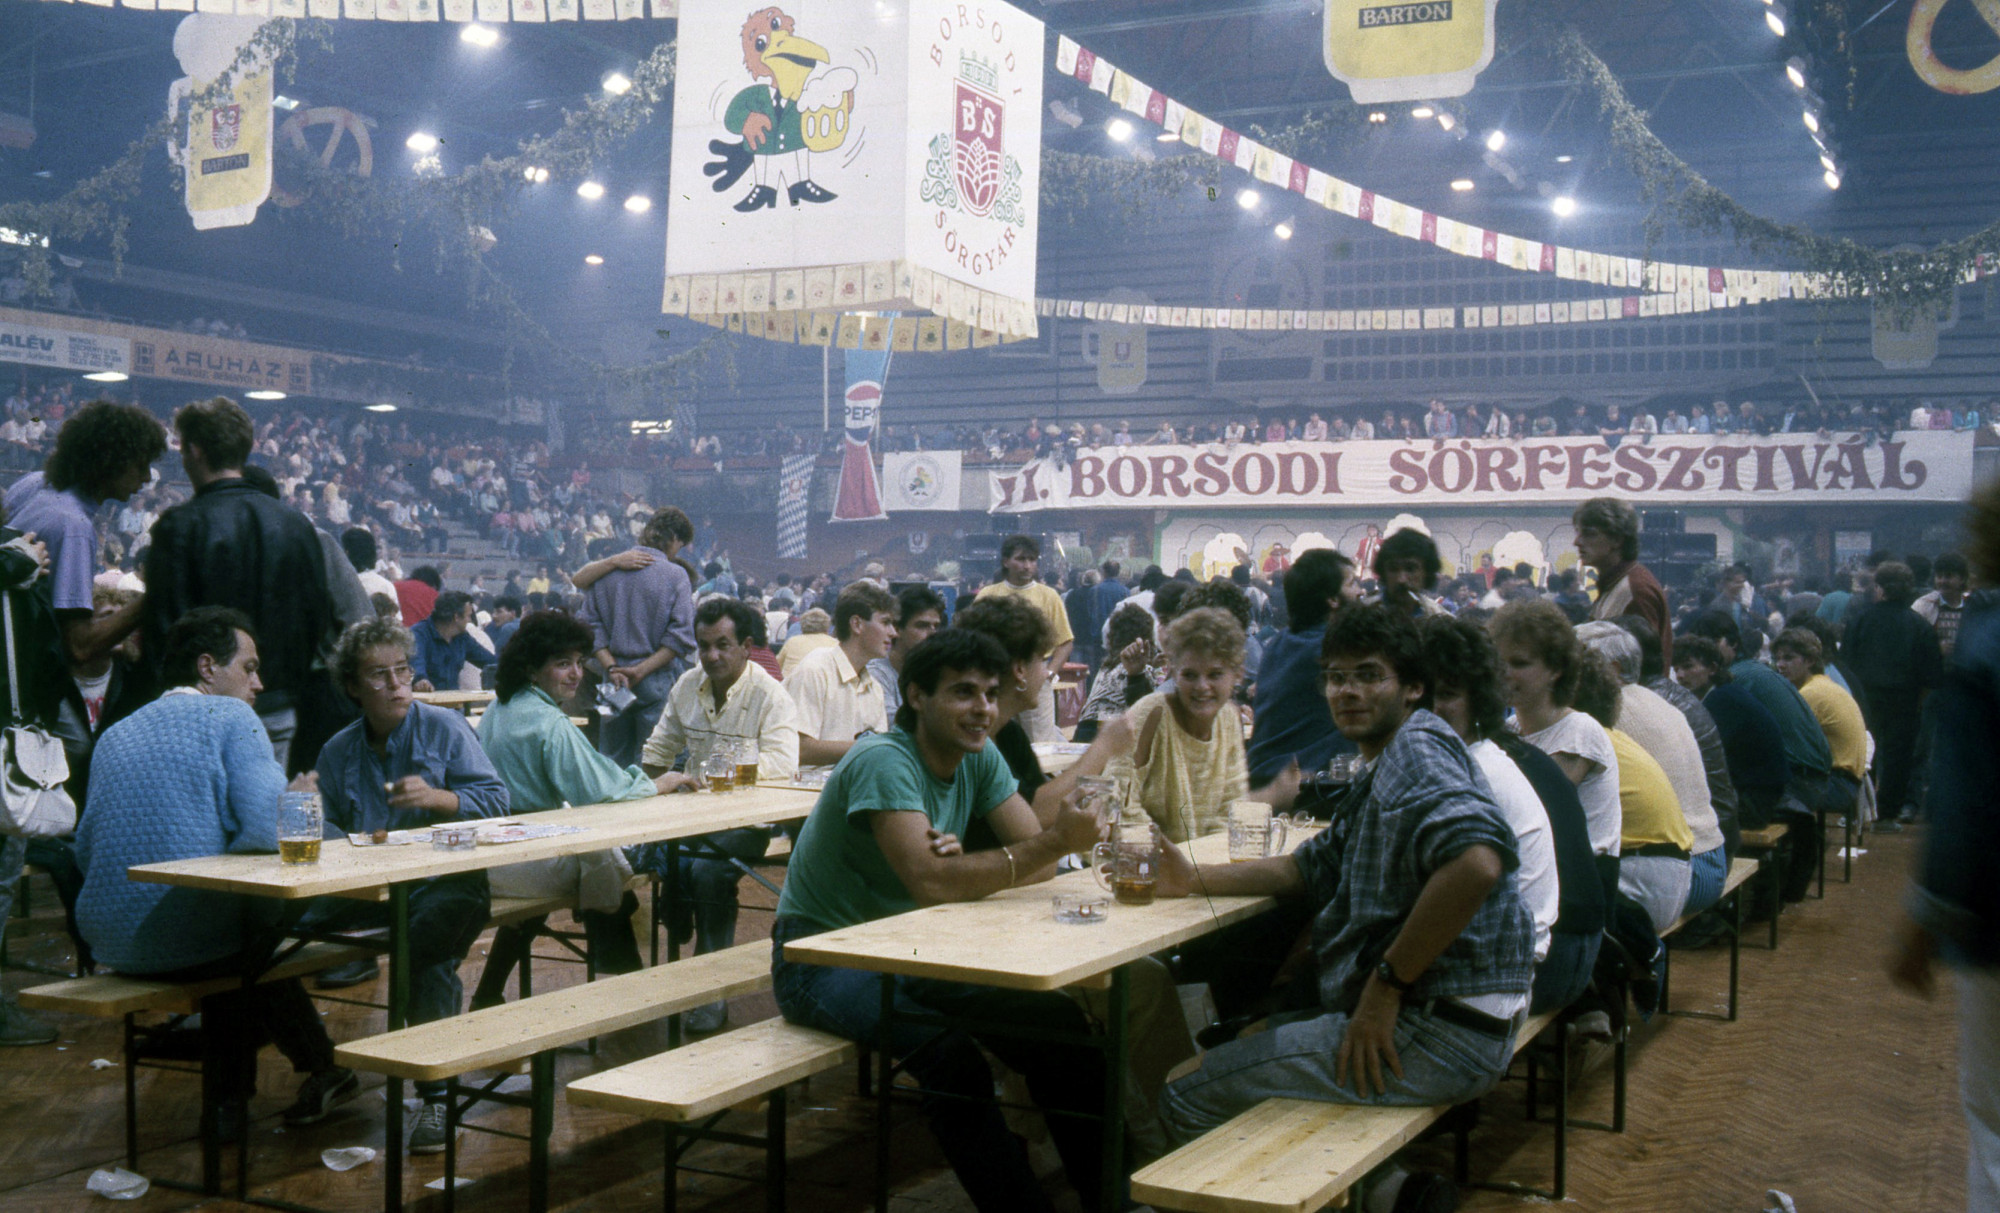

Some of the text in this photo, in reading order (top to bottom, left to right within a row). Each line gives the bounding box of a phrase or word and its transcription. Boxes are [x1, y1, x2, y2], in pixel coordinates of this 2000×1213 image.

[1362, 3, 1448, 25] BARTON
[929, 3, 1022, 95] BORSODI
[935, 209, 1015, 276] SÖRGYÁR
[1069, 451, 1344, 498] BORSODI
[1389, 435, 1927, 494] SÖRFESZTIVÁL
